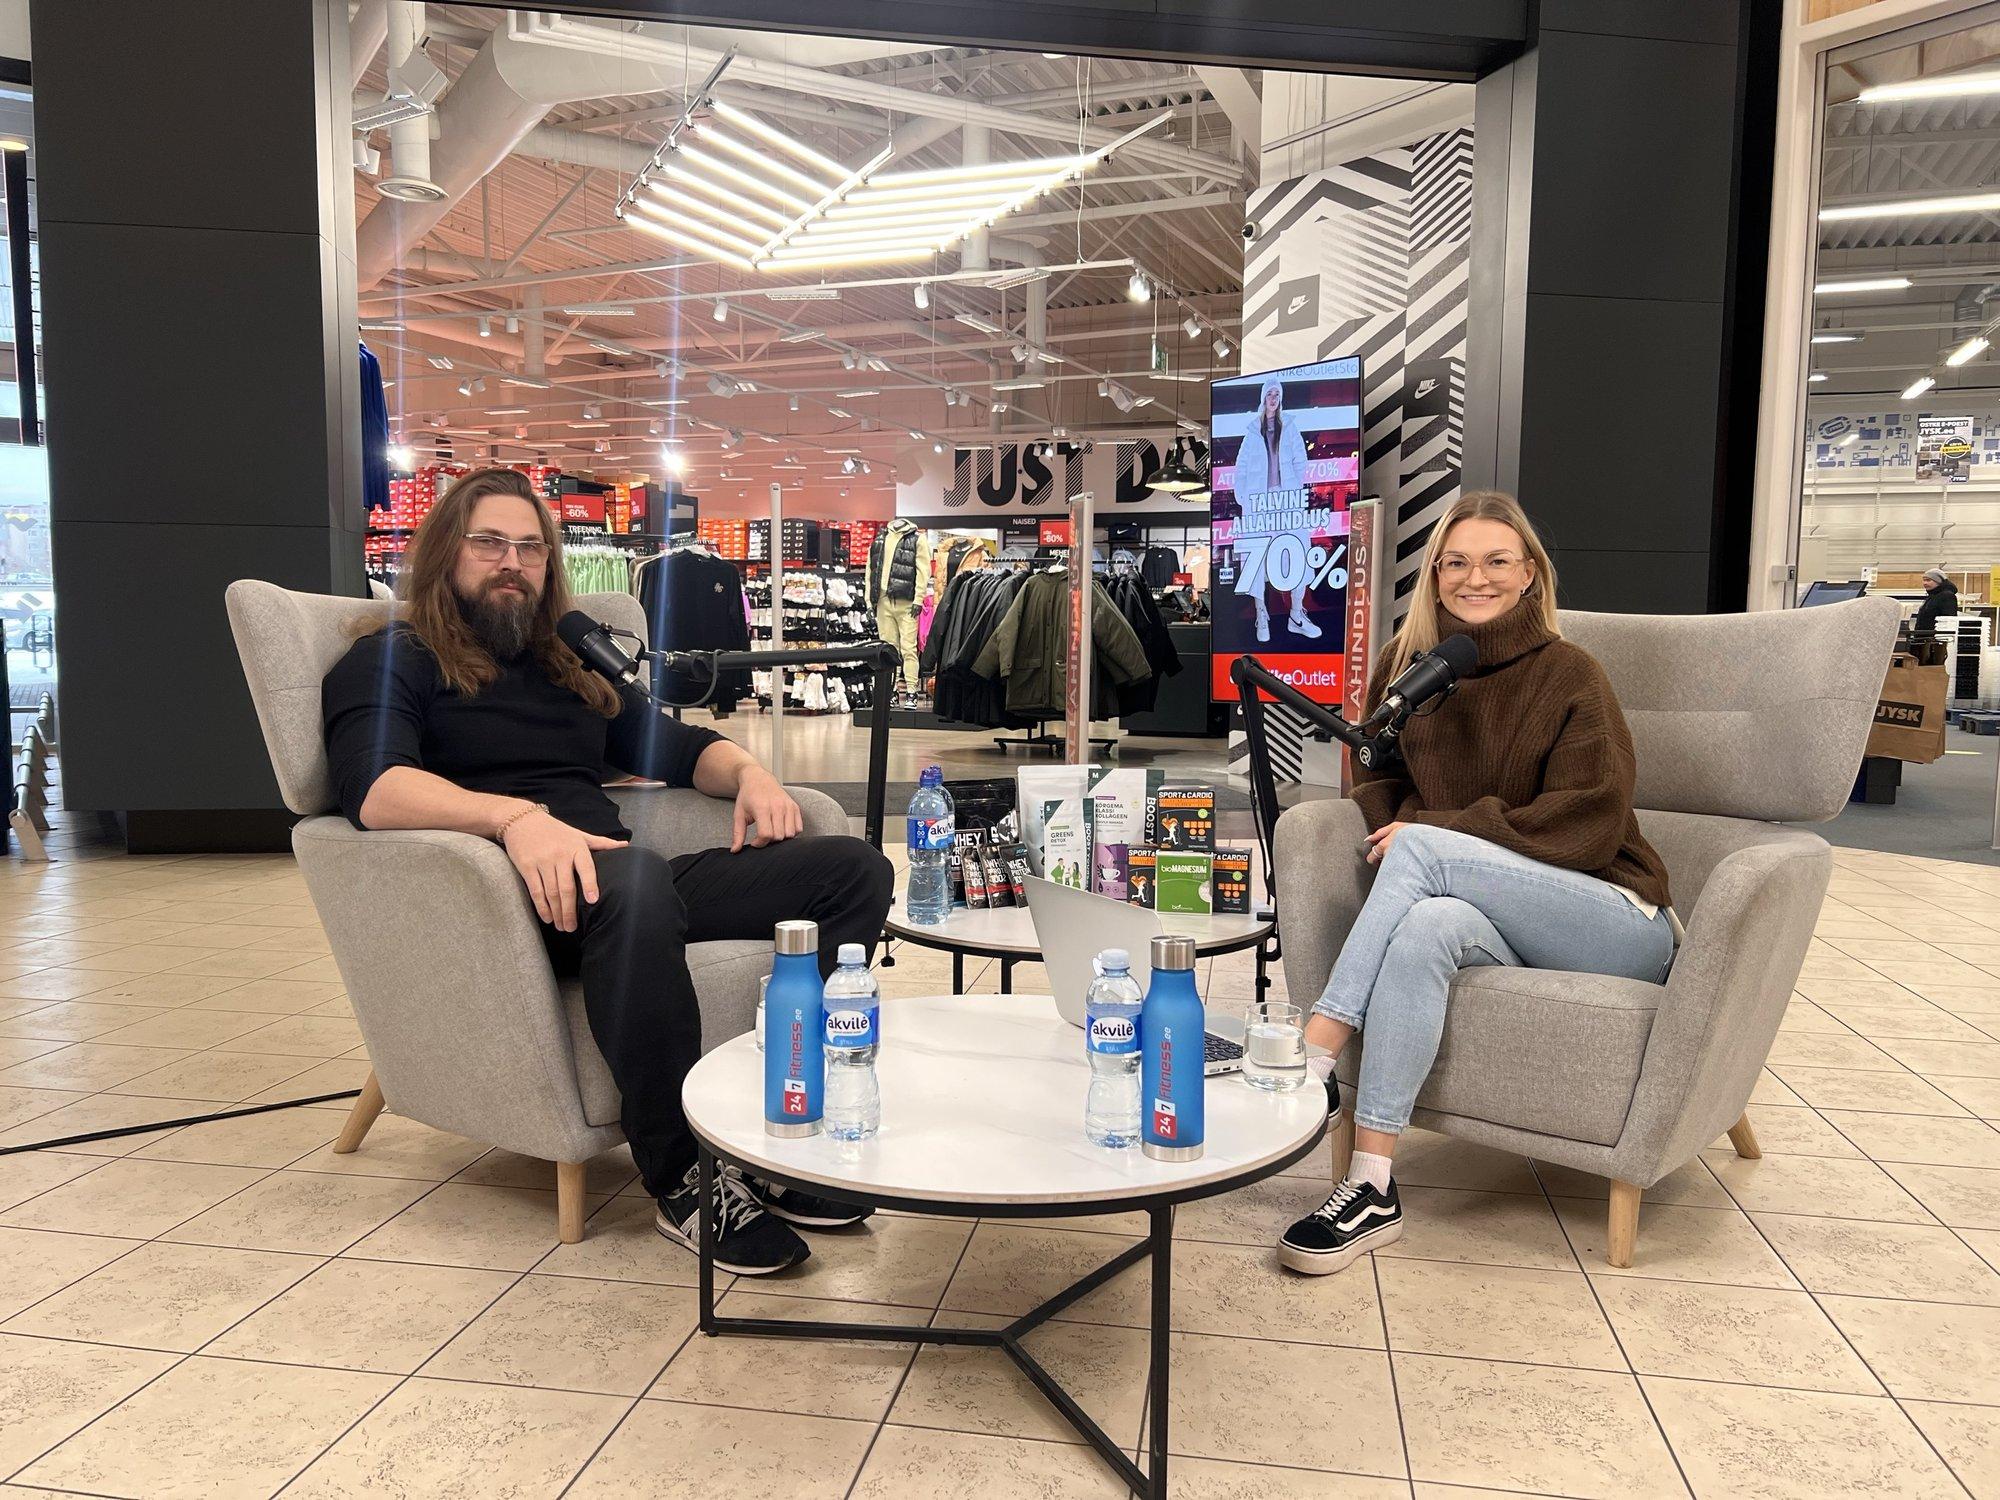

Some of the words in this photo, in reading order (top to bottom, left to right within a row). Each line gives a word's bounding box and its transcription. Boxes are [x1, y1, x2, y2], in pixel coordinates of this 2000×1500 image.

[1418, 378, 1436, 391] NIKE
[943, 438, 1093, 508] JUST
[1249, 488, 1310, 514] TALVINE
[566, 509, 589, 518] -60%
[1232, 507, 1330, 534] ALLAHINDLUS
[567, 525, 603, 533] TREENING
[1233, 533, 1348, 596] 70%
[1348, 545, 1368, 727] LAHINDLUS
[1877, 705, 1921, 723] JYSK
[1158, 791, 1181, 799] SPORT
[1187, 791, 1213, 799] CARDIO
[1145, 797, 1156, 836] BOOST
[1128, 849, 1150, 857] SPORT
[1221, 853, 1249, 861] CARDIO
[790, 1094, 802, 1112] 24
[1160, 1116, 1171, 1134] 24
